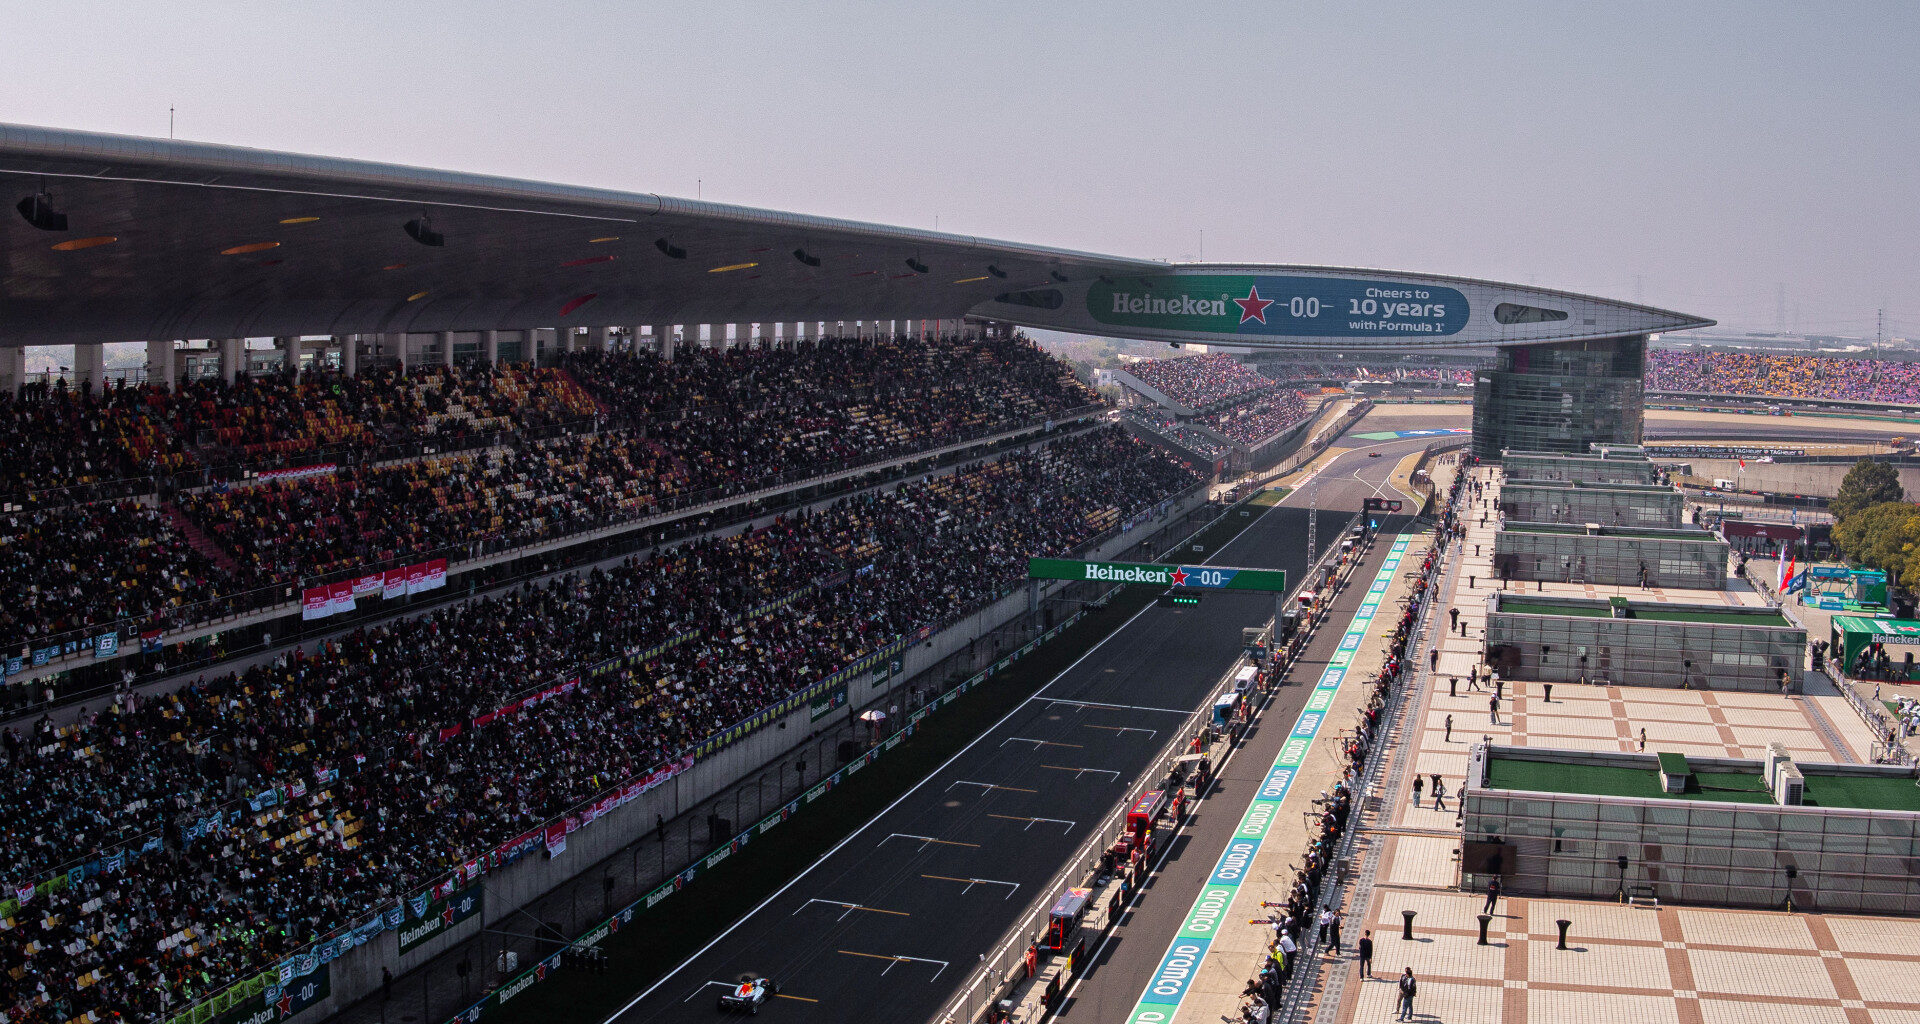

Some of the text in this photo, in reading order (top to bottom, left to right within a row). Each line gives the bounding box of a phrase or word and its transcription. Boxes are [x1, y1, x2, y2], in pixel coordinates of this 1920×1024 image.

[1112, 293, 1227, 316] Heineken
[1349, 299, 1376, 316] 10
[1382, 301, 1446, 319] years
[1366, 287, 1430, 299] Cheers to
[1349, 320, 1376, 331] with
[1379, 321, 1433, 332] Formula
[1085, 564, 1167, 583] Heineken
[100, 638, 113, 651] 63
[1871, 633, 1920, 645] Heineken
[1242, 804, 1274, 835] aramco
[1217, 844, 1254, 880] aramco
[1188, 890, 1230, 933] aramco
[400, 917, 440, 948] Heineken
[1153, 945, 1200, 996] aramco
[499, 974, 534, 1005] Heineken
